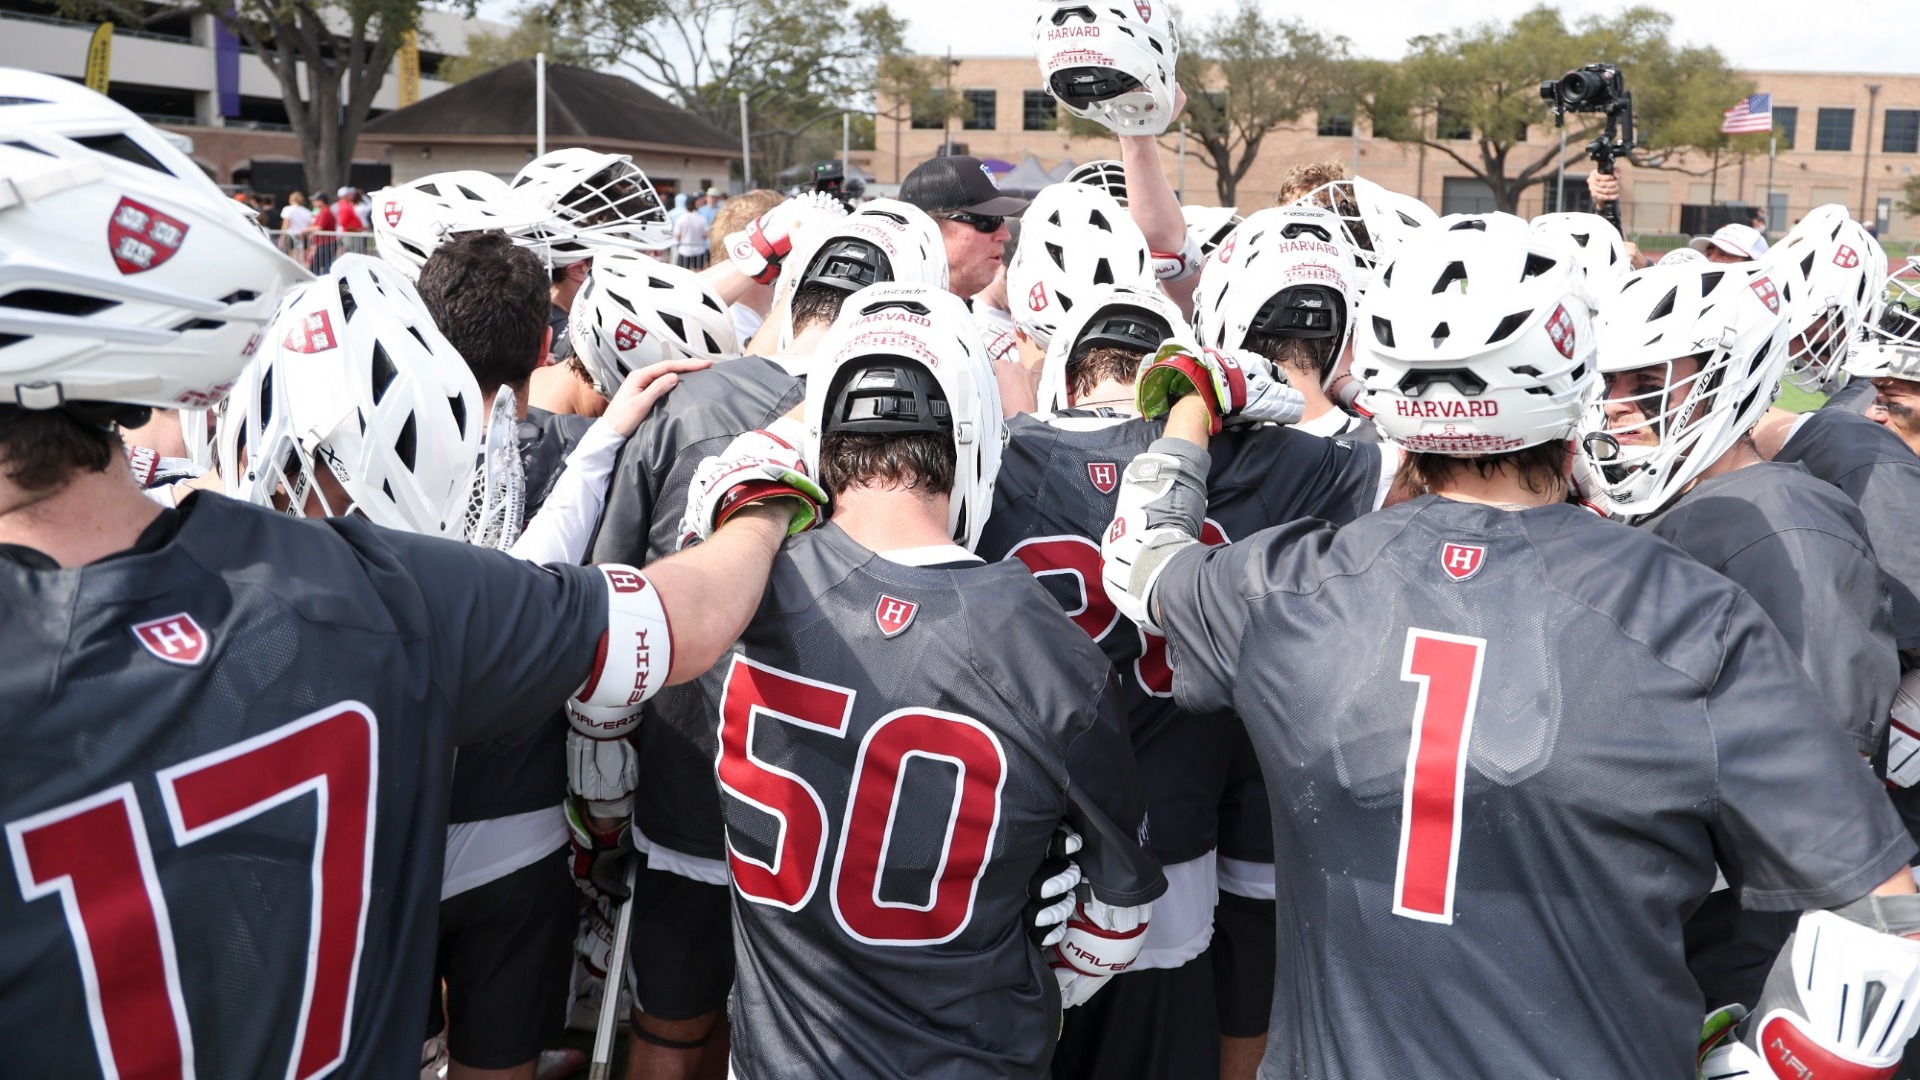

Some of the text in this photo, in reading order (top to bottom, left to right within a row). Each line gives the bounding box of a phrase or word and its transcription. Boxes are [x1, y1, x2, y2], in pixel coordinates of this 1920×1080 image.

[1047, 25, 1100, 41] HARVARD
[1279, 240, 1339, 257] HARVARD
[848, 312, 932, 330] HARVARD
[1395, 399, 1499, 418] HARVARD
[1094, 466, 1112, 484] H
[1449, 547, 1475, 570] H
[611, 573, 640, 589] H
[881, 600, 907, 624] H
[149, 621, 197, 655] H
[1393, 626, 1488, 925] 1
[714, 651, 1008, 947] 50
[5, 698, 379, 1080] 17
